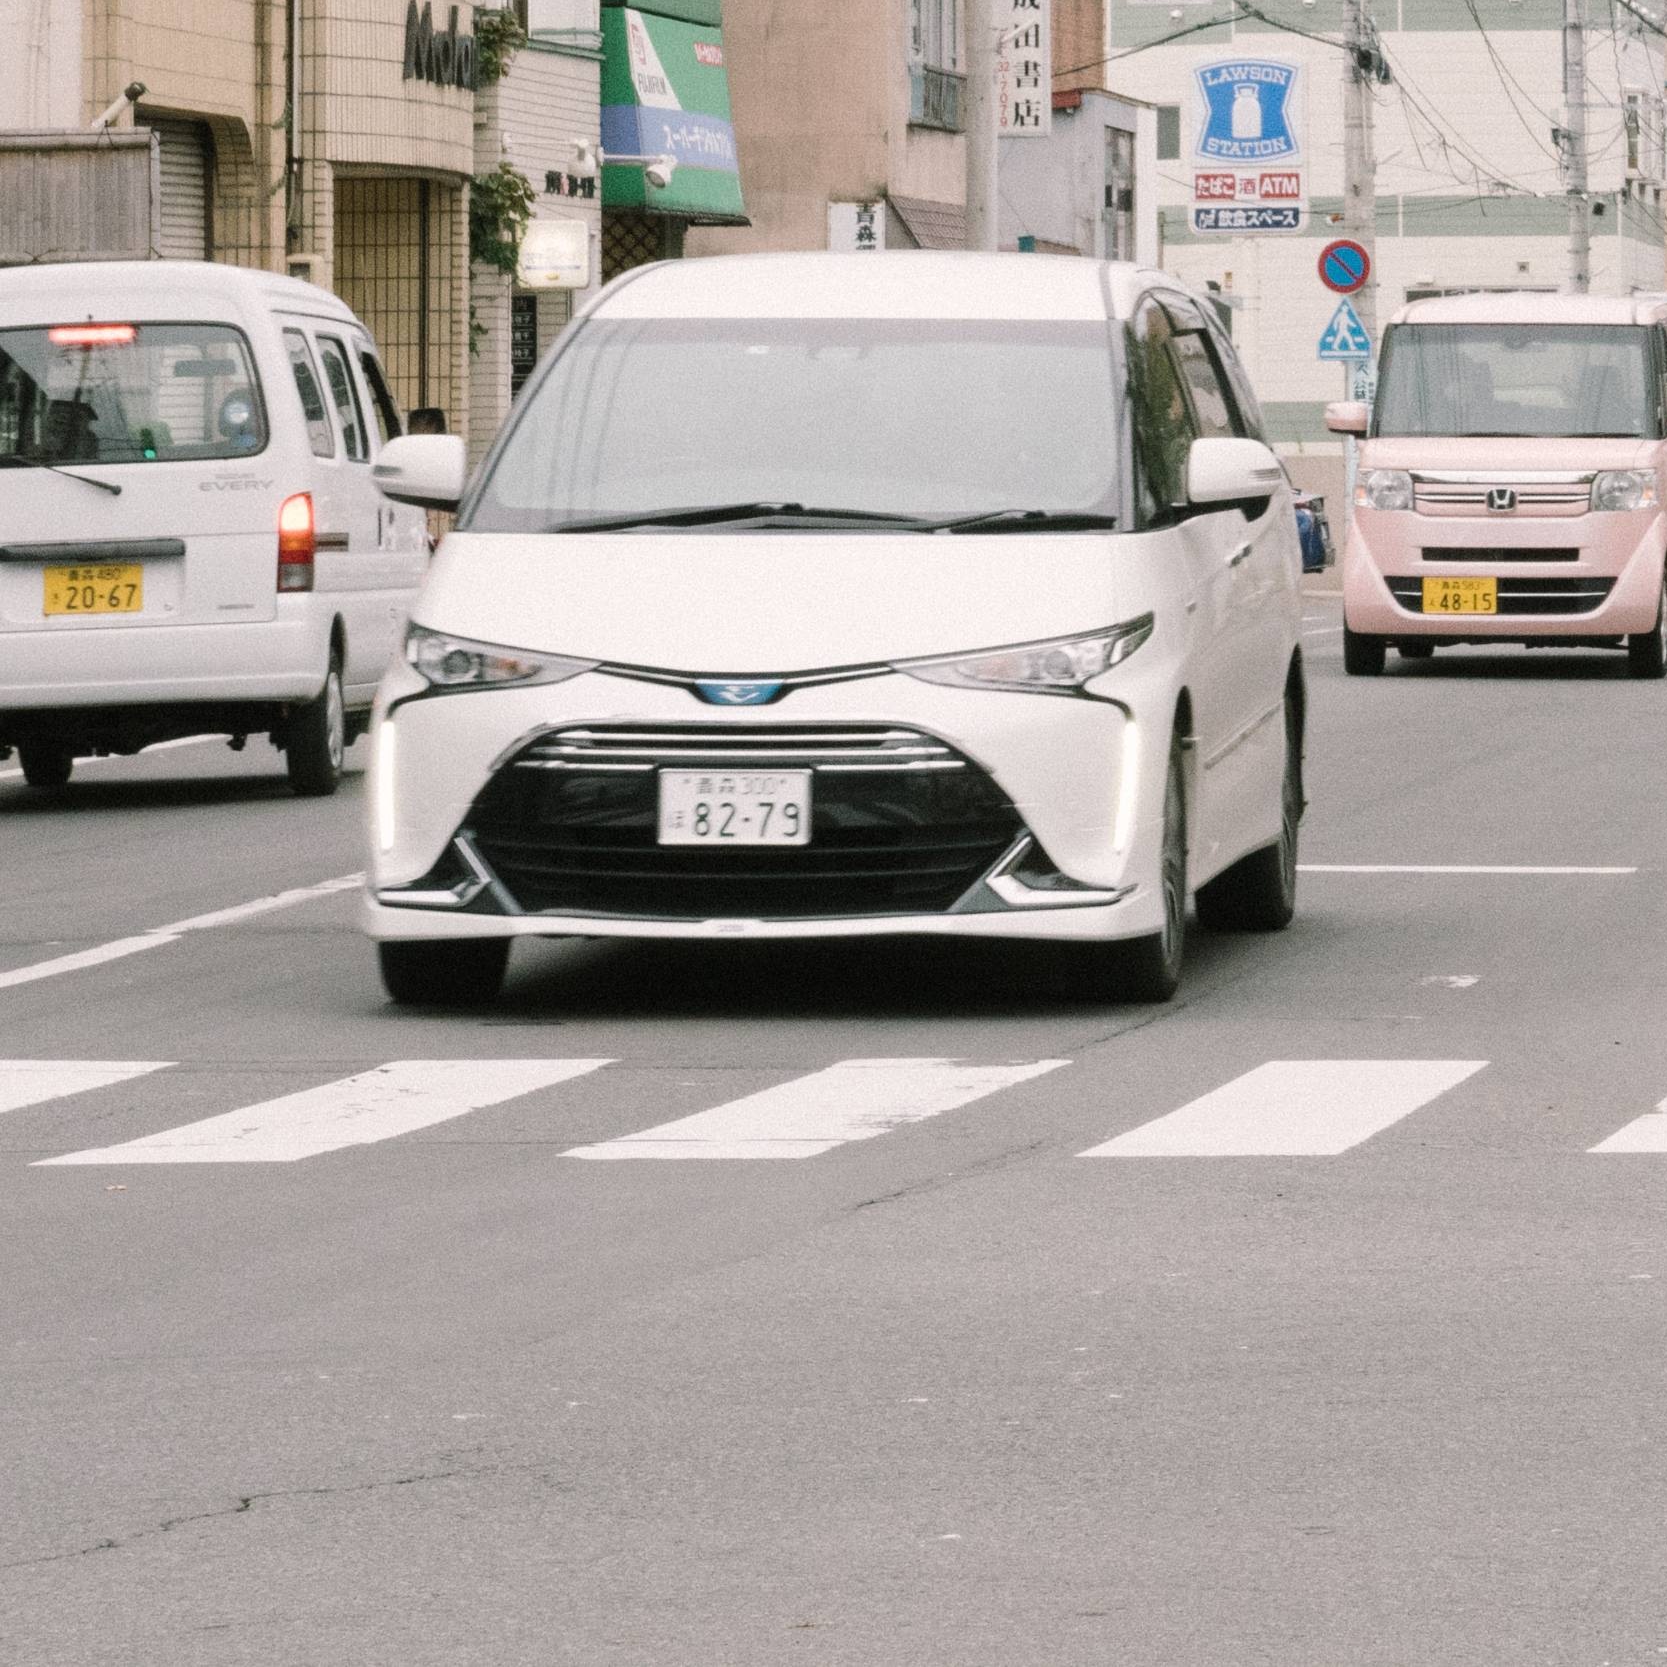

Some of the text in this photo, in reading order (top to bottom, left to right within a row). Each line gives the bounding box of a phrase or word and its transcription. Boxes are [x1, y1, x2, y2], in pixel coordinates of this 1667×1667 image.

[1205, 65, 1289, 86] LAWSON
[1206, 135, 1288, 157] STATION
[1196, 176, 1298, 197] たばこ 酒 ATM
[1218, 208, 1297, 228] 飲食スペース
[199, 479, 275, 492] EVERY
[65, 582, 137, 610] 20-67
[1440, 593, 1492, 611] 48-15
[697, 777, 775, 795] 青森 300
[695, 802, 799, 837] 82-79
